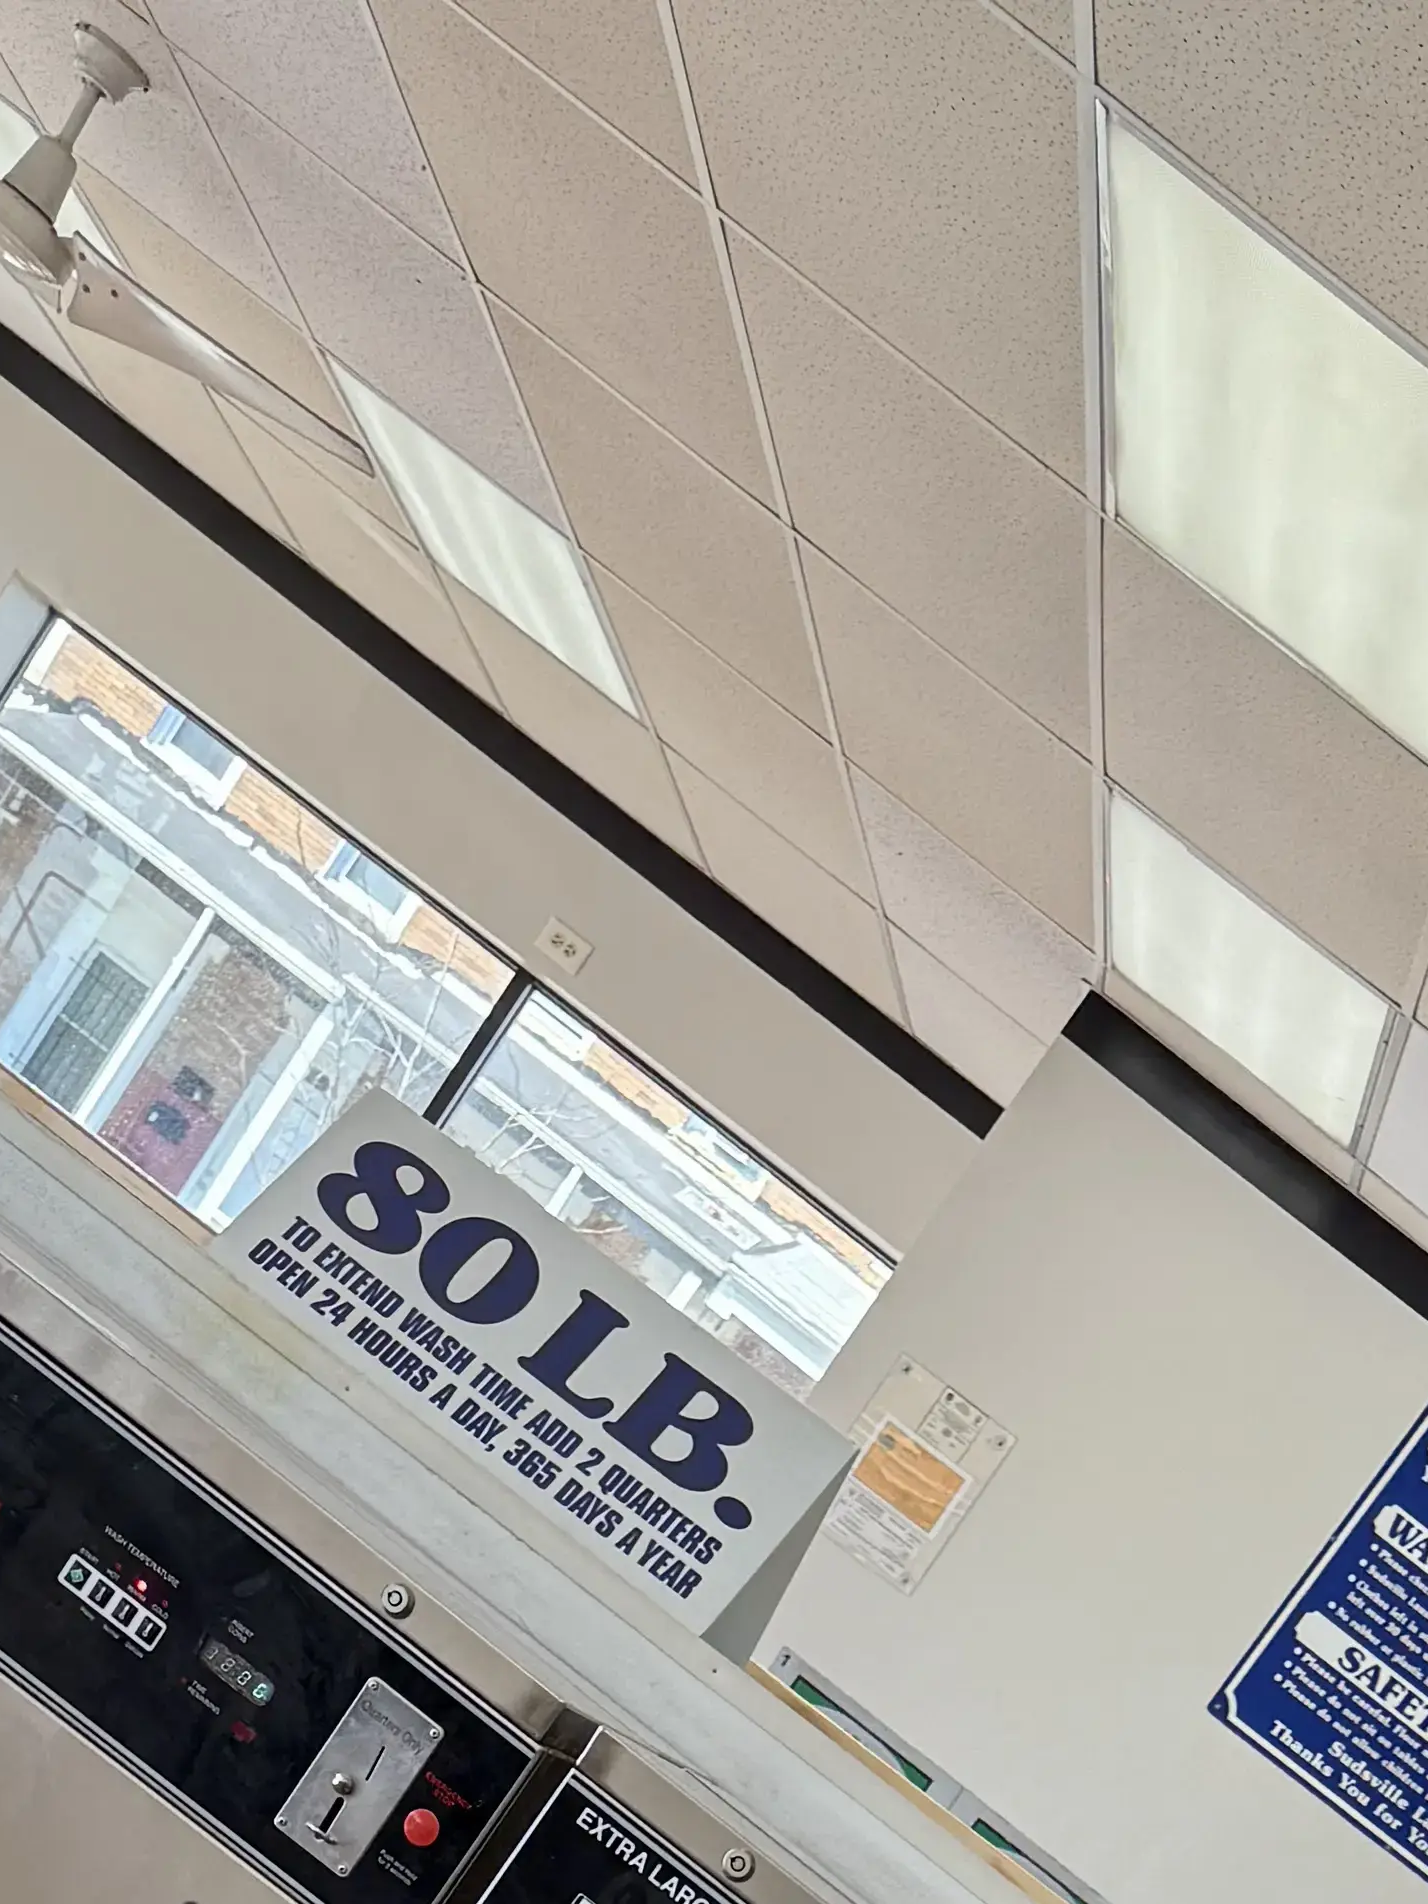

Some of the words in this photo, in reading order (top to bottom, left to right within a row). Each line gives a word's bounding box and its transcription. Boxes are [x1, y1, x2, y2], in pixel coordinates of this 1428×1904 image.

[248, 1238, 319, 1298] OPEN
[309, 1288, 355, 1326] 24
[347, 1316, 437, 1392] HOURS
[428, 1383, 457, 1410] A
[450, 1397, 507, 1451] DAY,
[502, 1437, 562, 1489] 365
[553, 1477, 623, 1537] DAYS
[614, 1526, 643, 1555] A
[637, 1538, 702, 1598] YEAR
[281, 1215, 321, 1252] TO
[312, 1242, 404, 1318] EXTEND
[398, 1306, 476, 1375] WASH
[469, 1362, 533, 1420] TIME
[523, 1409, 583, 1458] ADD
[575, 1447, 605, 1476] 2
[598, 1463, 722, 1564] QUARTERS
[316, 1141, 539, 1324] 80
[516, 1288, 753, 1529] LB.
[574, 1806, 652, 1875] EXTRA
[1270, 1719, 1333, 1776] Thanks
[1338, 1772, 1370, 1806] You
[1373, 1803, 1402, 1829] for
[1327, 1741, 1408, 1809] Sudsville
